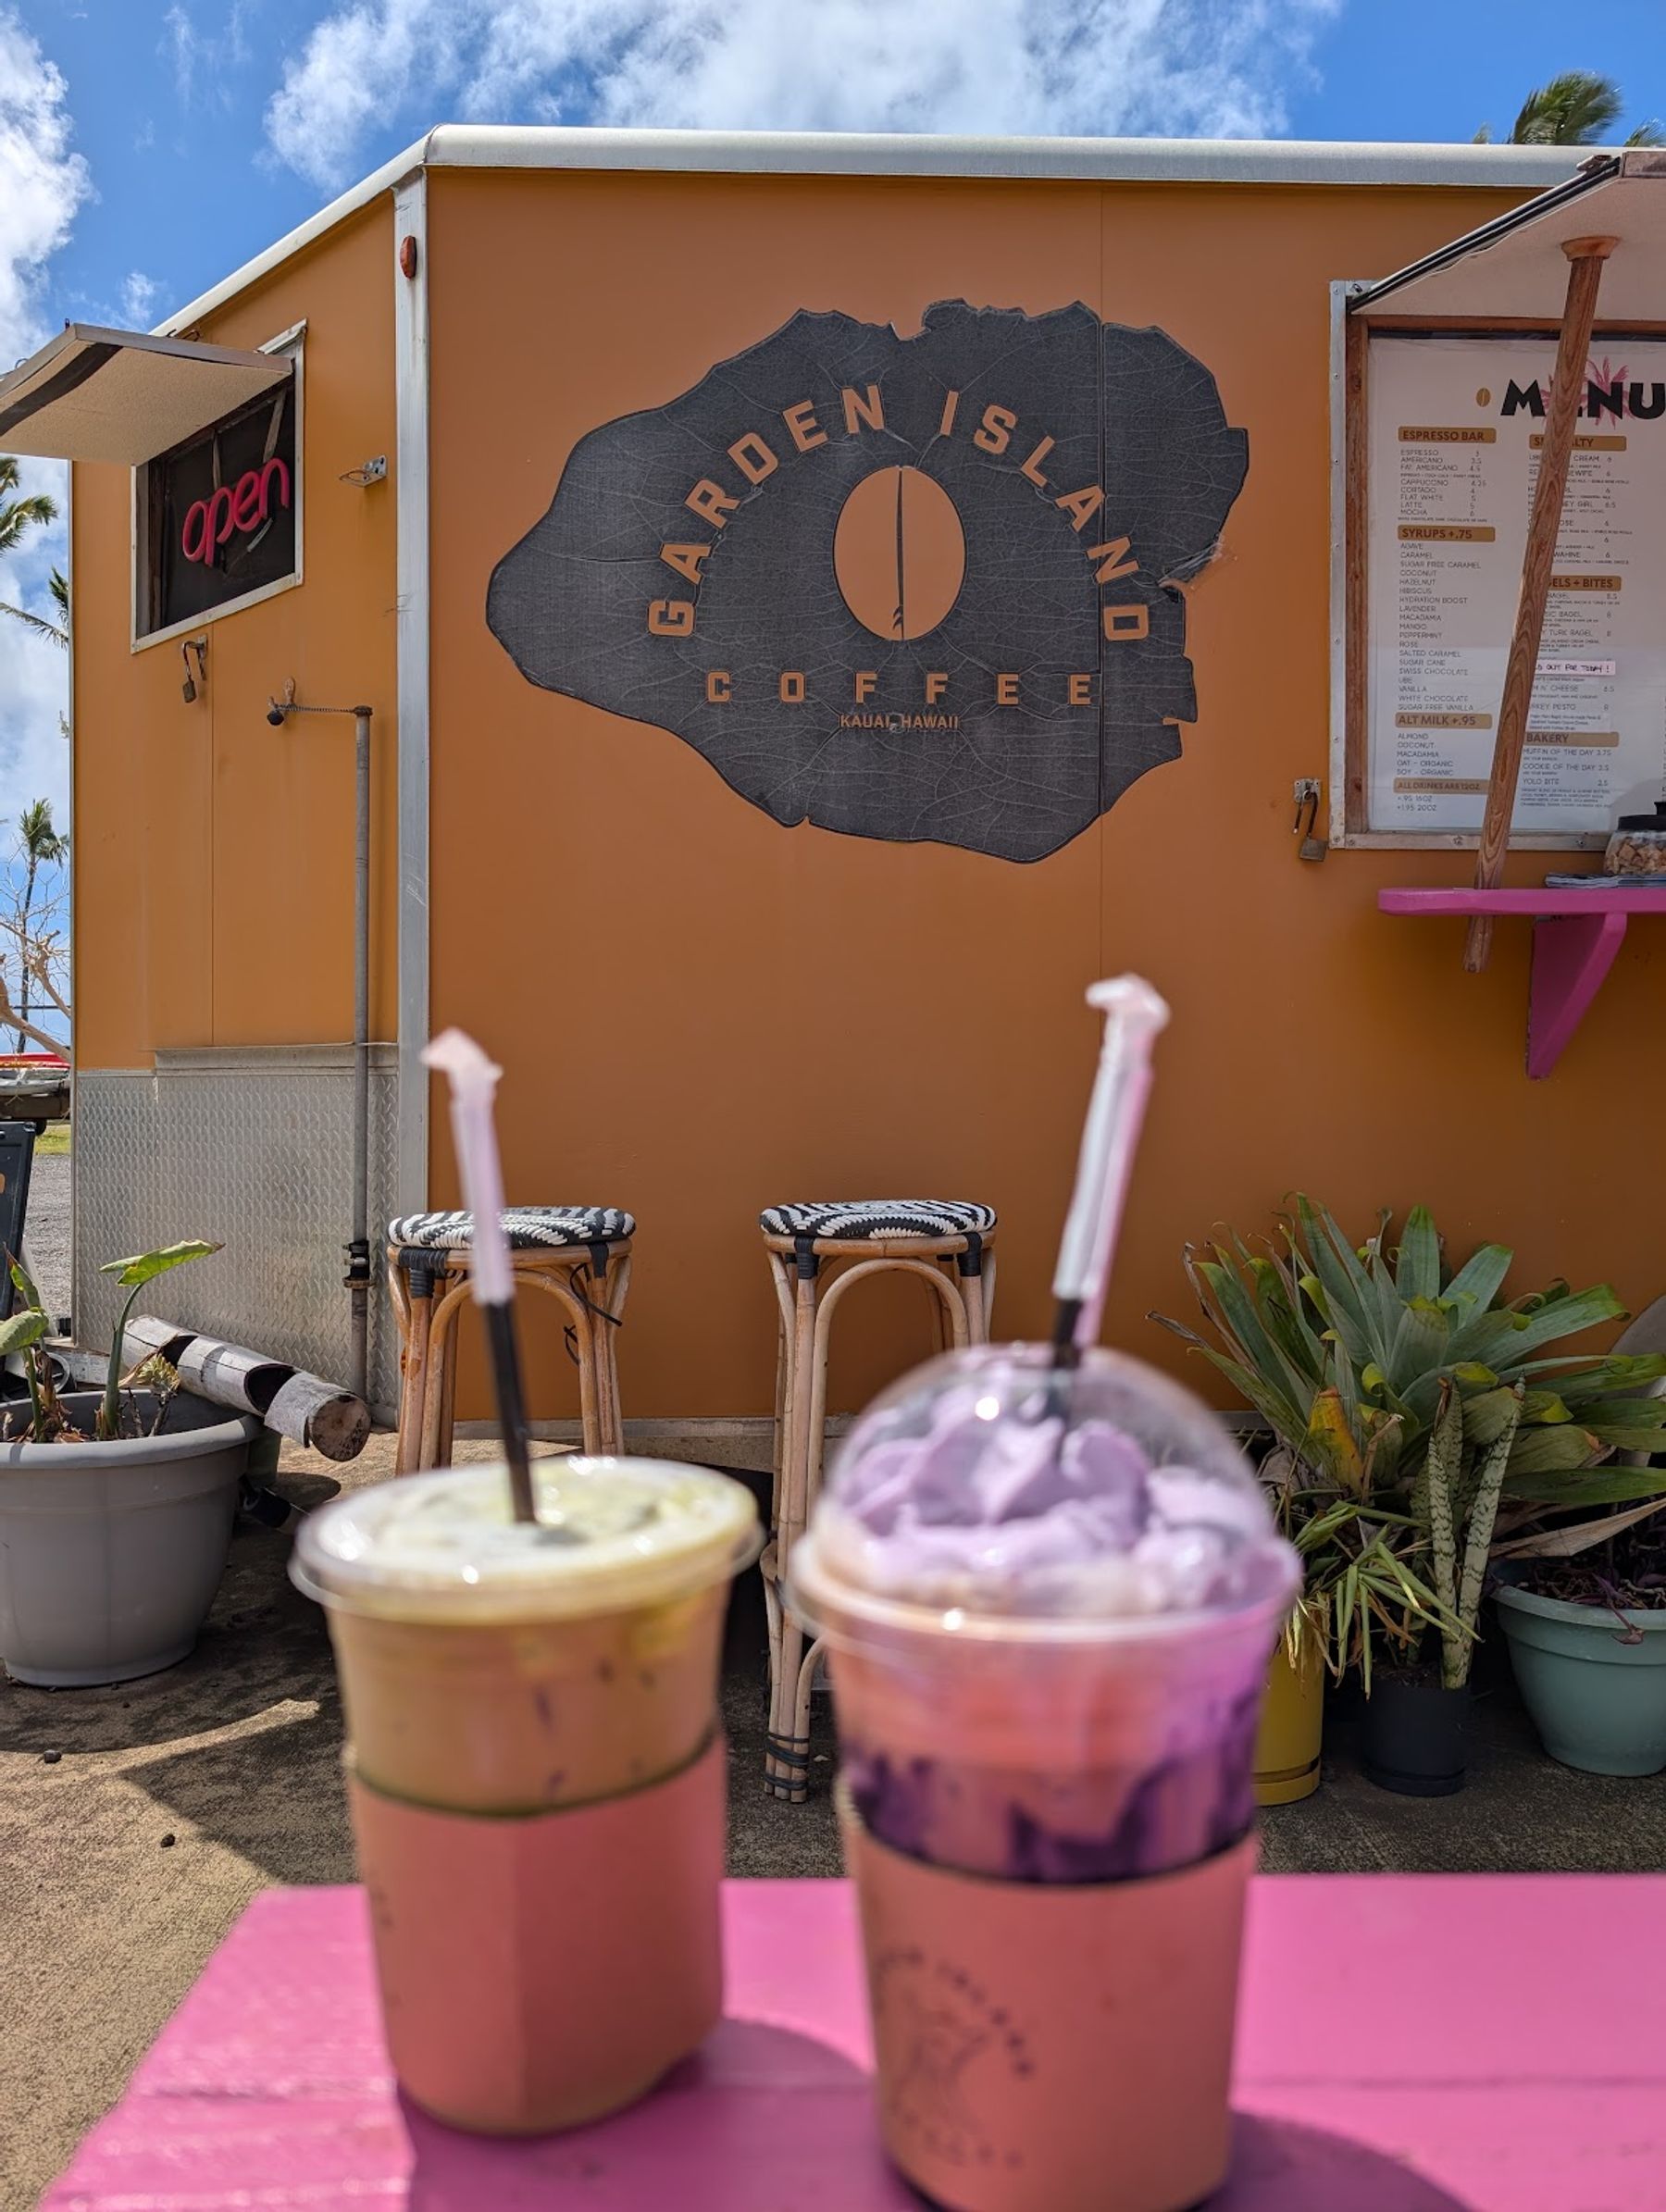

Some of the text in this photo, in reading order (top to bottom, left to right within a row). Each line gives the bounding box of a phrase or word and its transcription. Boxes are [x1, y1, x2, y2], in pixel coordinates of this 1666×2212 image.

[1500, 379, 1666, 420] MNU
[1403, 431, 1485, 441] ESPRESSO BAR
[181, 457, 291, 567] open
[647, 384, 1150, 642] GARDEN ISLAND
[1402, 529, 1446, 539] SYRUPS
[1583, 579, 1612, 588] BITES
[706, 671, 1093, 705] COFFEE
[901, 715, 959, 728] HAWAII
[1399, 715, 1418, 724] ALT
[1422, 715, 1448, 725] MILK
[1527, 733, 1569, 743] BAKERY
